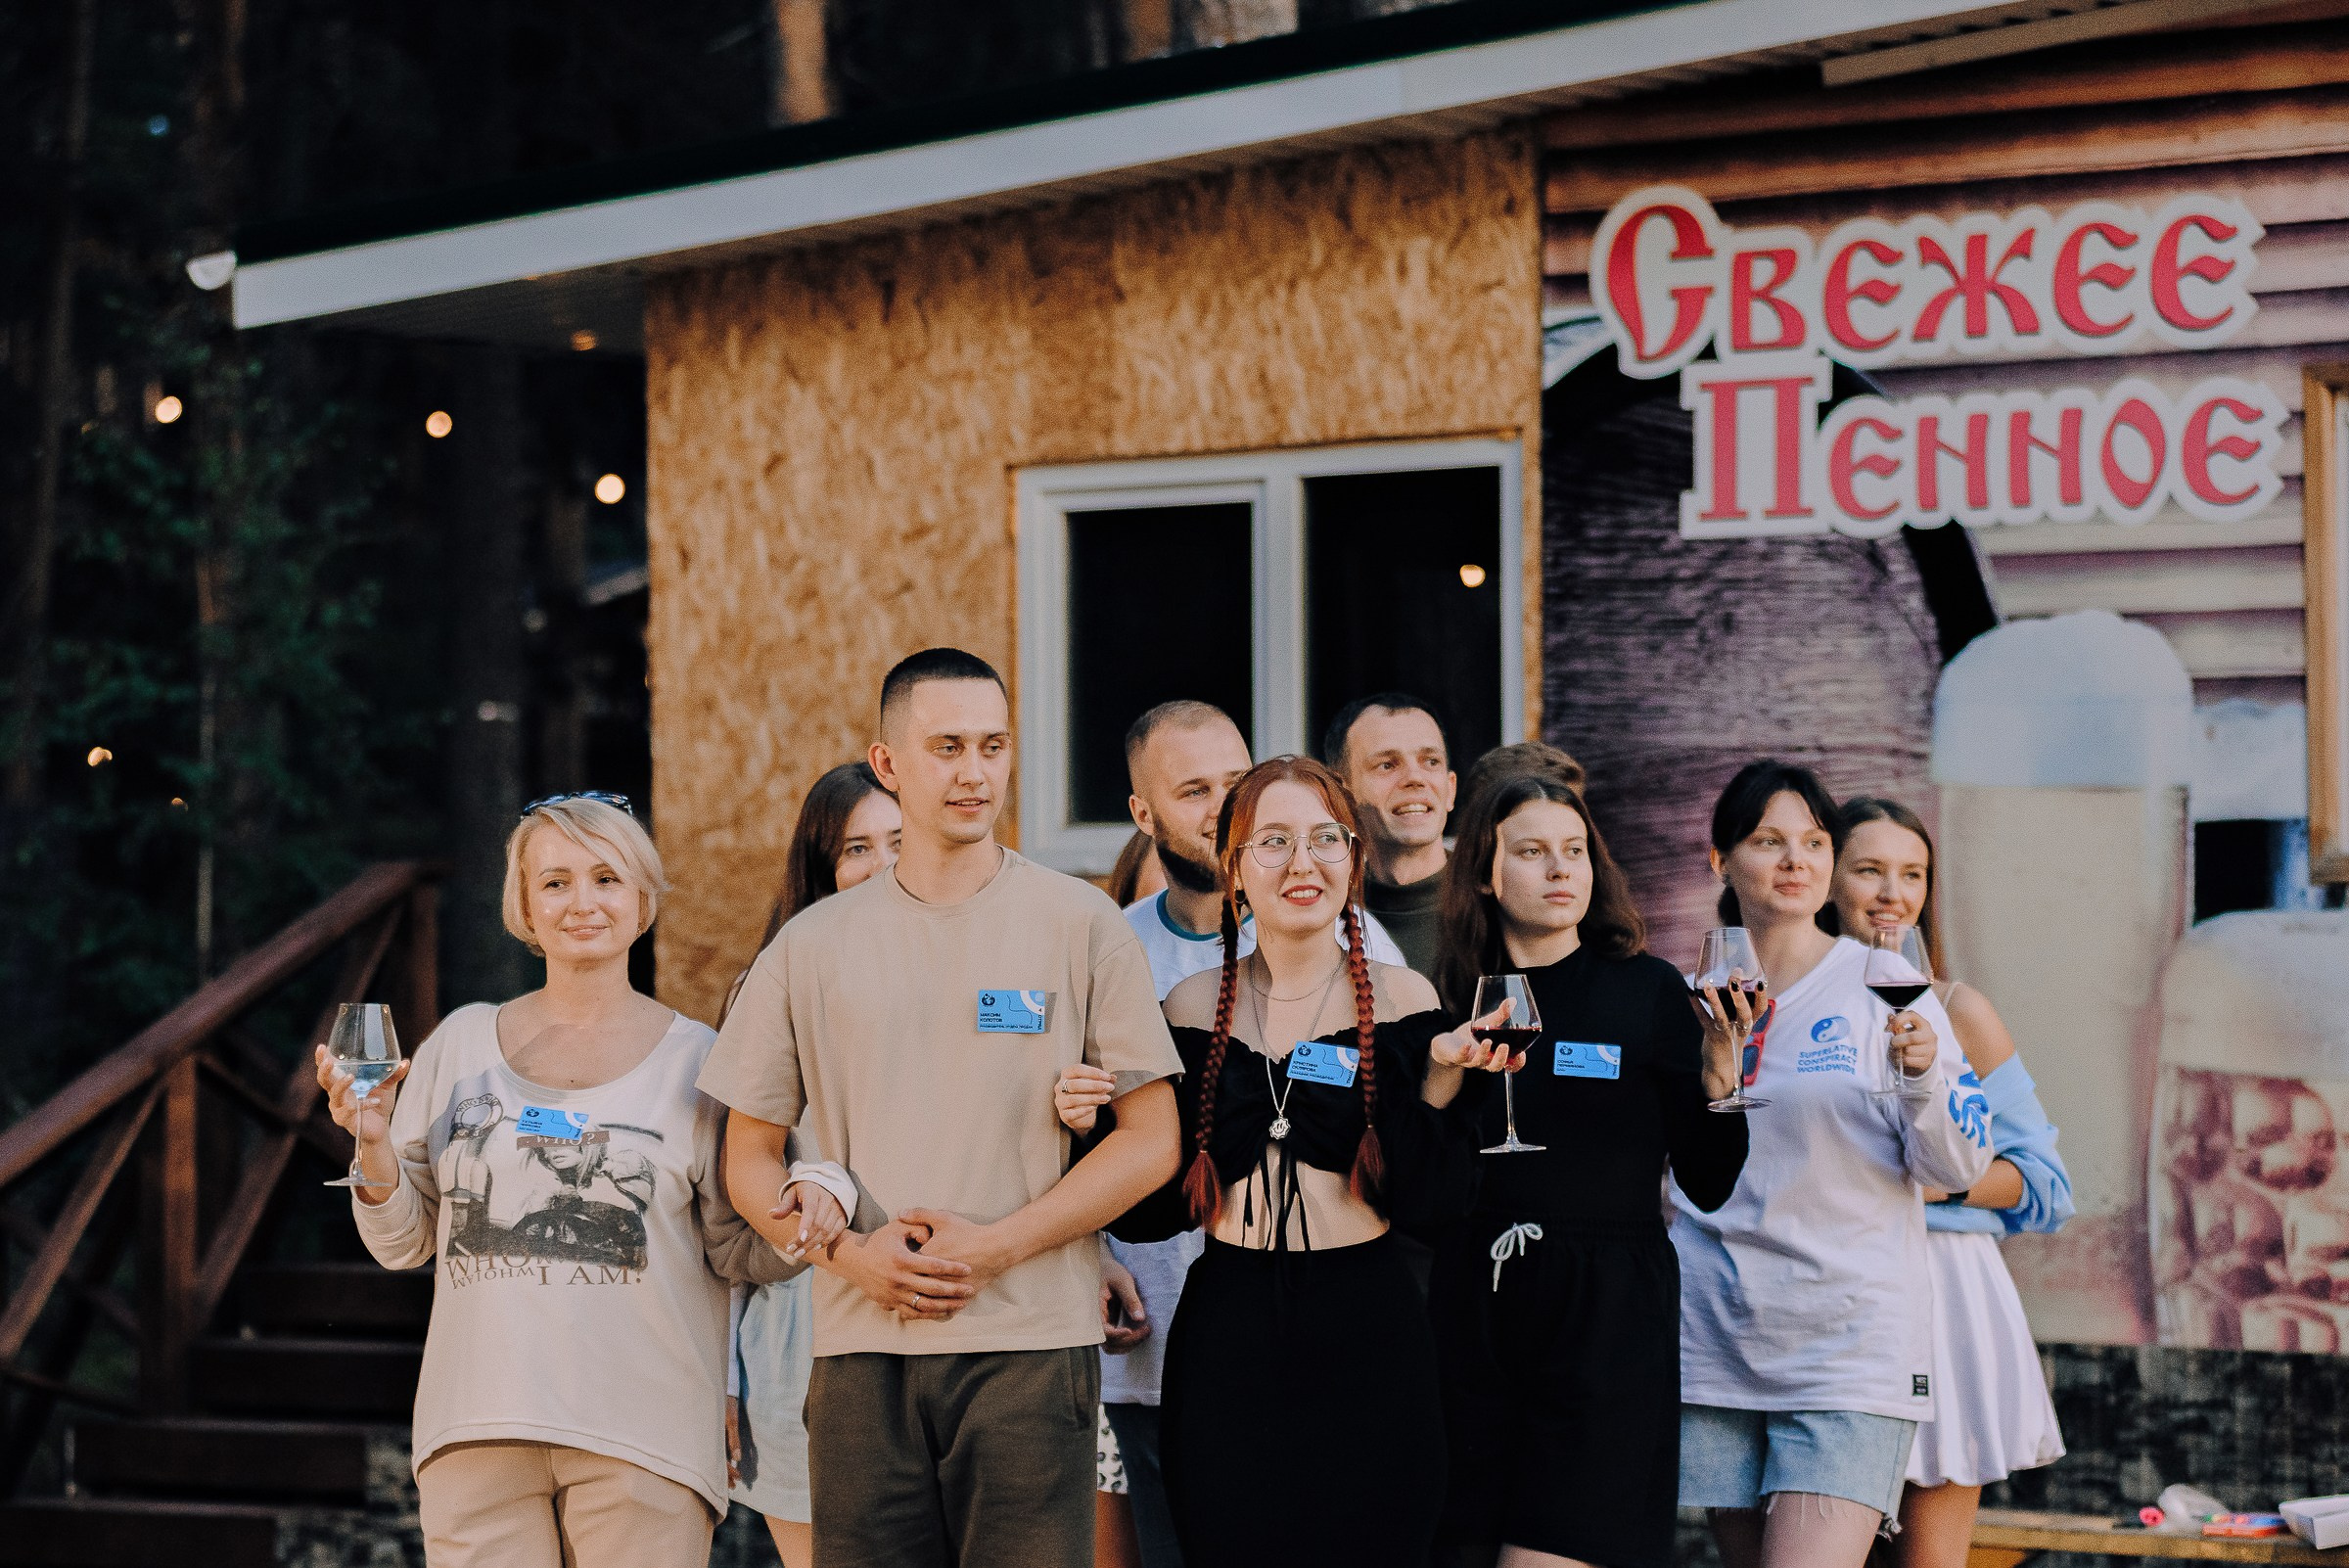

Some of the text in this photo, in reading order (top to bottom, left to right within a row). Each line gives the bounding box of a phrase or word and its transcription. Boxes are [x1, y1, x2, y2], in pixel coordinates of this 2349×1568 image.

[1799, 1044, 1858, 1058] SUPERLATIVE
[1797, 1053, 1856, 1066] CONSPIRACY
[1797, 1063, 1856, 1076] WORLDWIDE
[444, 1250, 531, 1280] WHO
[537, 1265, 552, 1286] I
